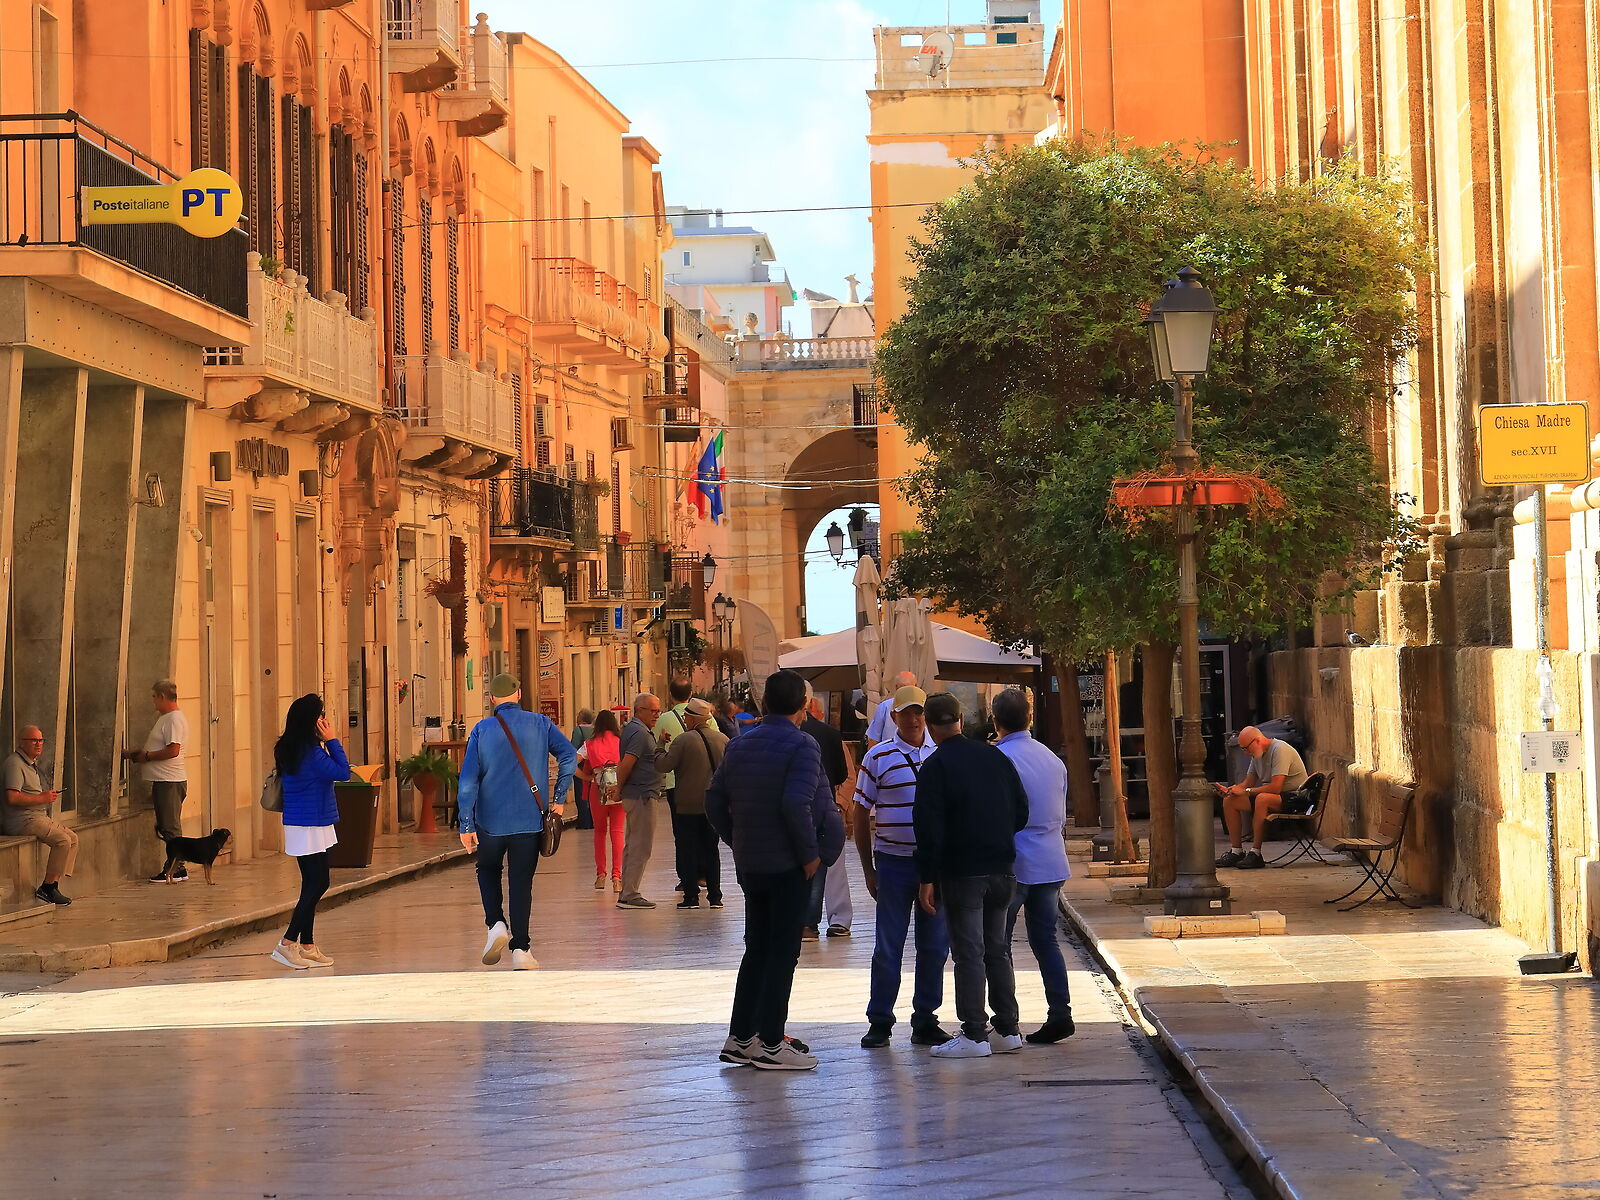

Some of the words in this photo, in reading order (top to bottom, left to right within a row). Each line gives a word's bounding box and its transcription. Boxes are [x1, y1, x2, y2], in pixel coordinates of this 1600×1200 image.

[182, 188, 230, 217] PT
[1495, 416, 1529, 429] Chiesa
[1536, 414, 1571, 428] Madre
